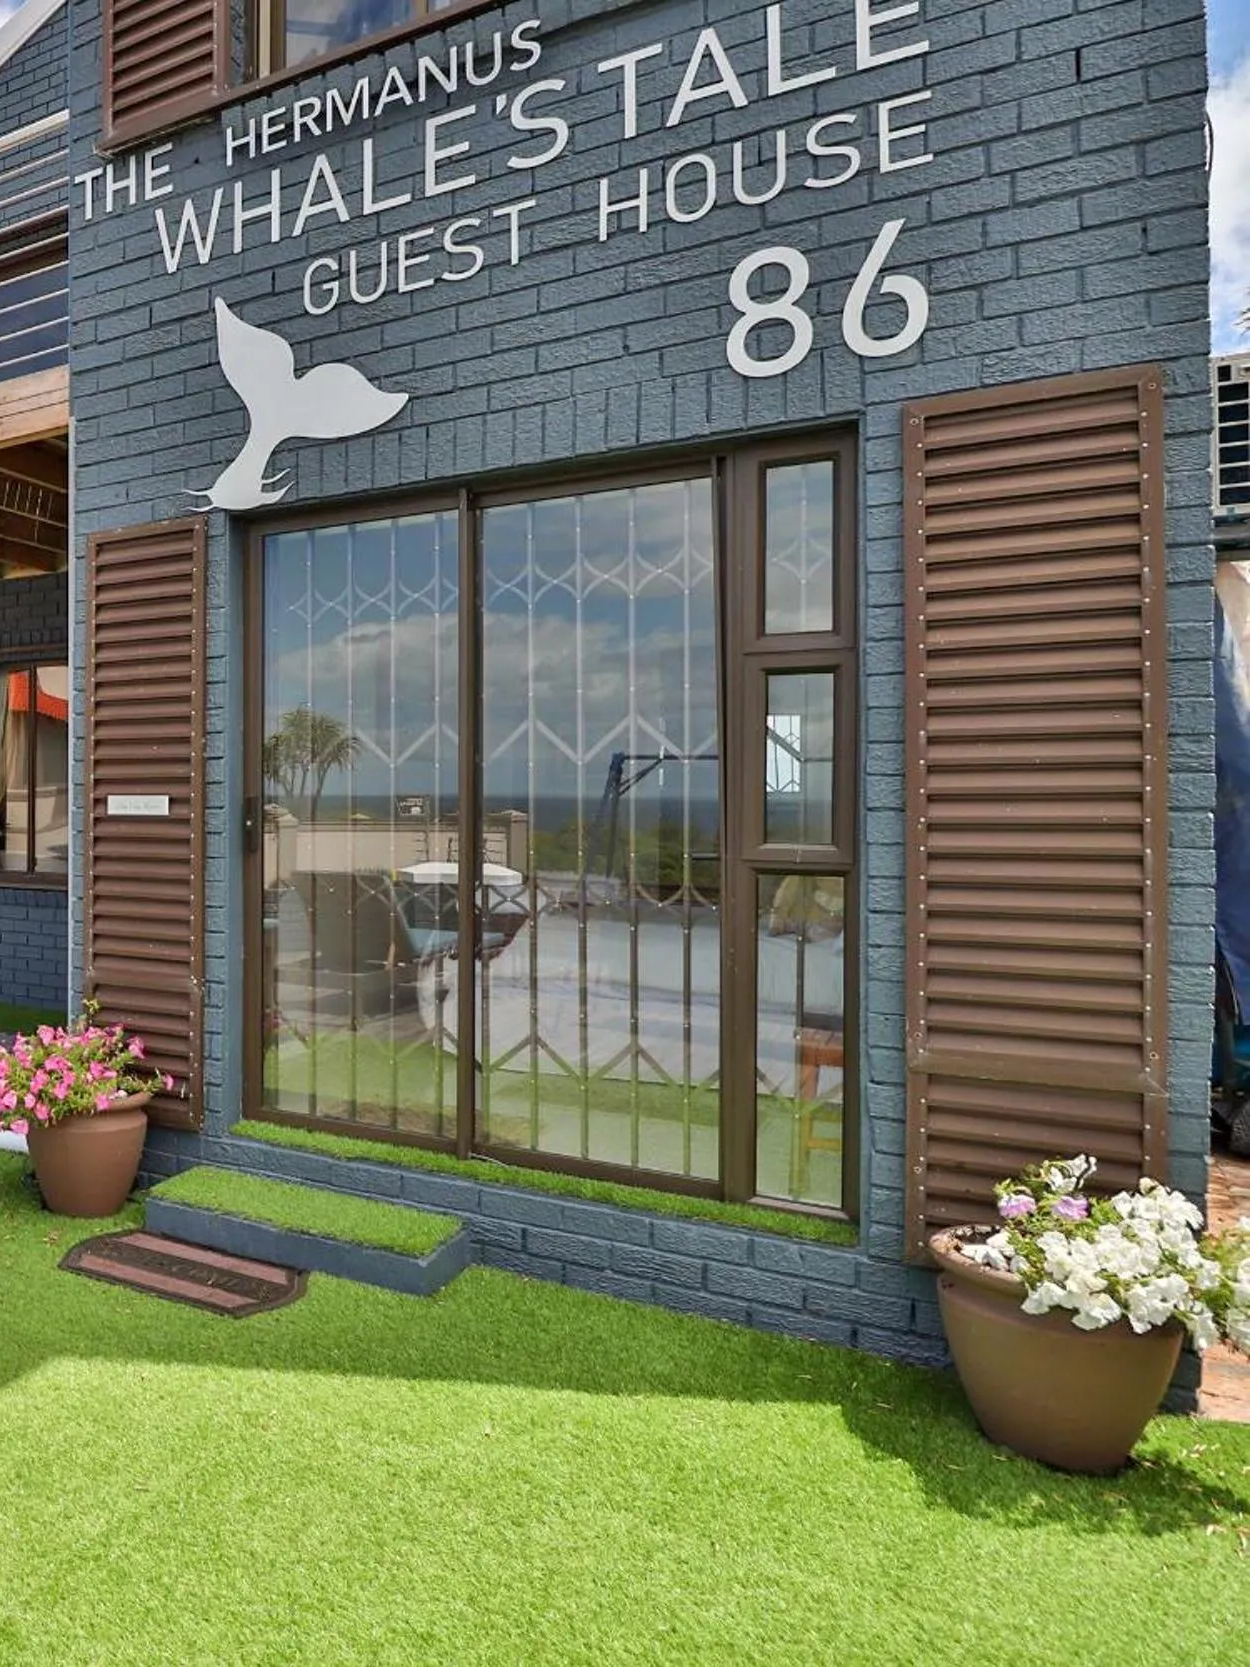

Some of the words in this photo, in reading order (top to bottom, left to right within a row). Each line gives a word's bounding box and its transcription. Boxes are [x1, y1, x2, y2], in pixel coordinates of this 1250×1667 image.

[74, 142, 175, 221] THE
[225, 19, 542, 168] HERMANUS
[154, 78, 570, 275] WHALE'S
[597, 0, 930, 139] TALE
[302, 199, 537, 316] GUEST
[599, 89, 934, 242] HOUSE
[725, 217, 930, 379] 86
